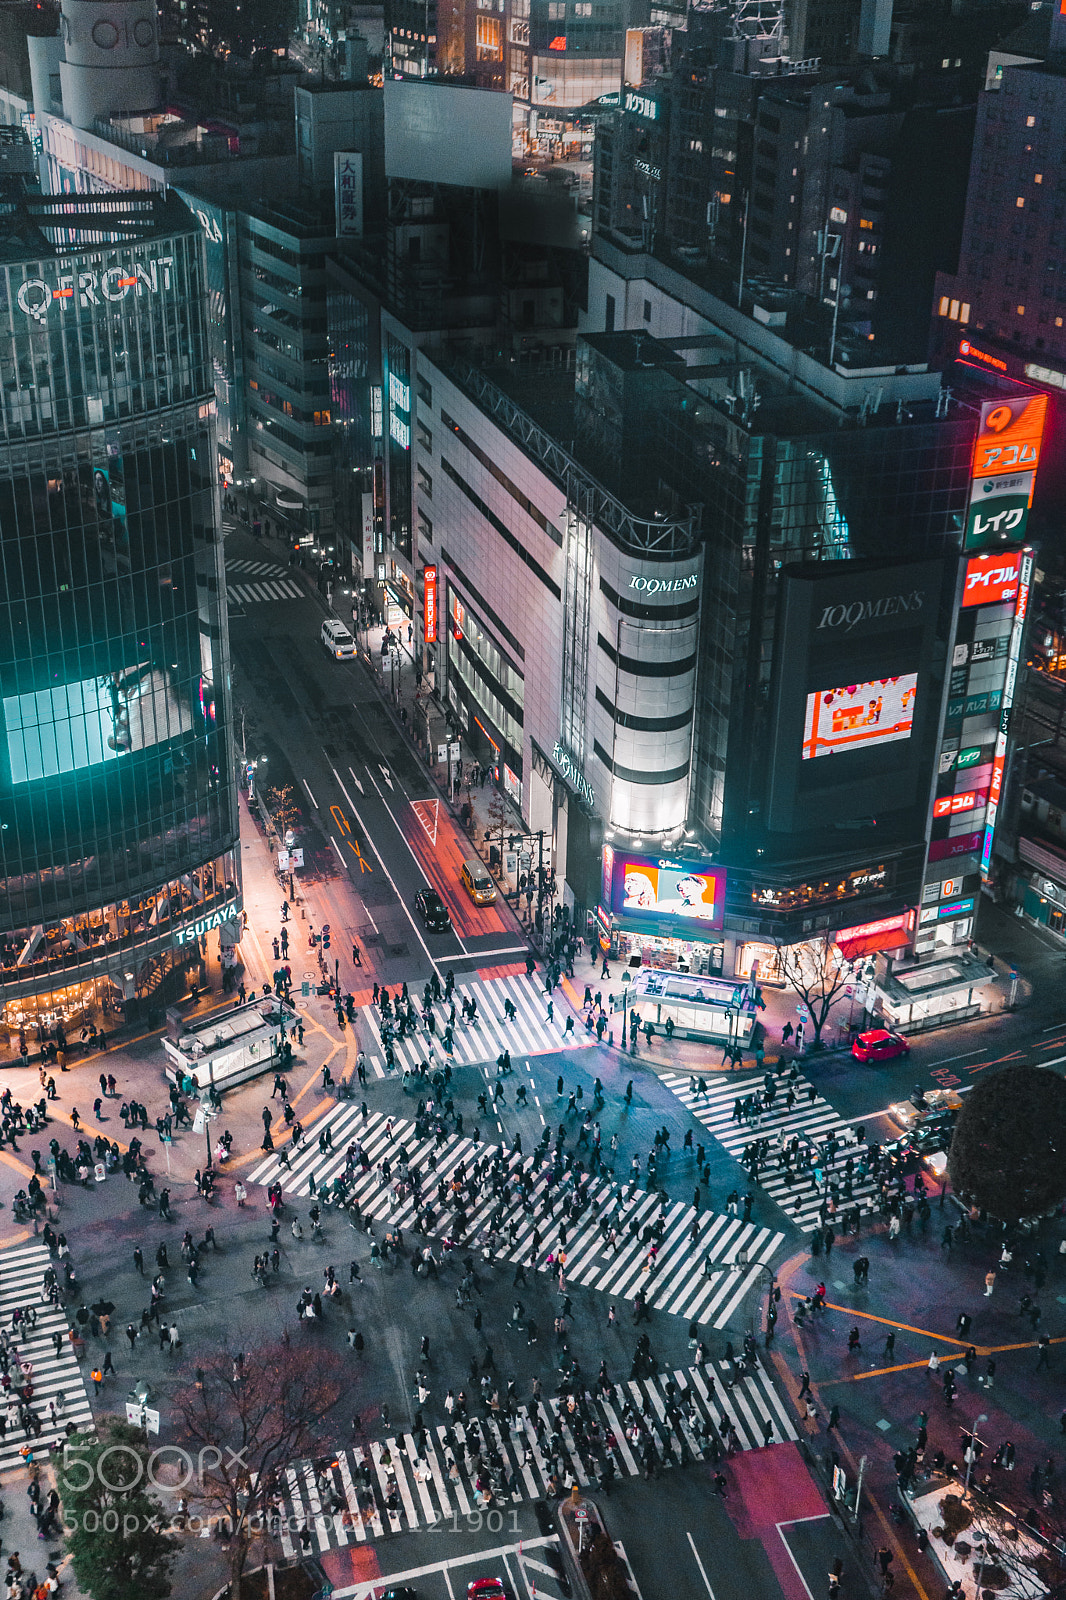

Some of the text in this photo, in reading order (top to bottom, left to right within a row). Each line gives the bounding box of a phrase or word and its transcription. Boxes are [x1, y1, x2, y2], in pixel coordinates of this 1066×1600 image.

[982, 444, 1037, 468] アコム
[973, 508, 1024, 535] レイク
[967, 566, 1019, 589] アイフル
[1002, 589, 1016, 599] 8F
[957, 750, 981, 764] レイク
[938, 795, 974, 813] アコム
[175, 904, 237, 945] TSUTAYA
[930, 1068, 962, 1087] 8-20
